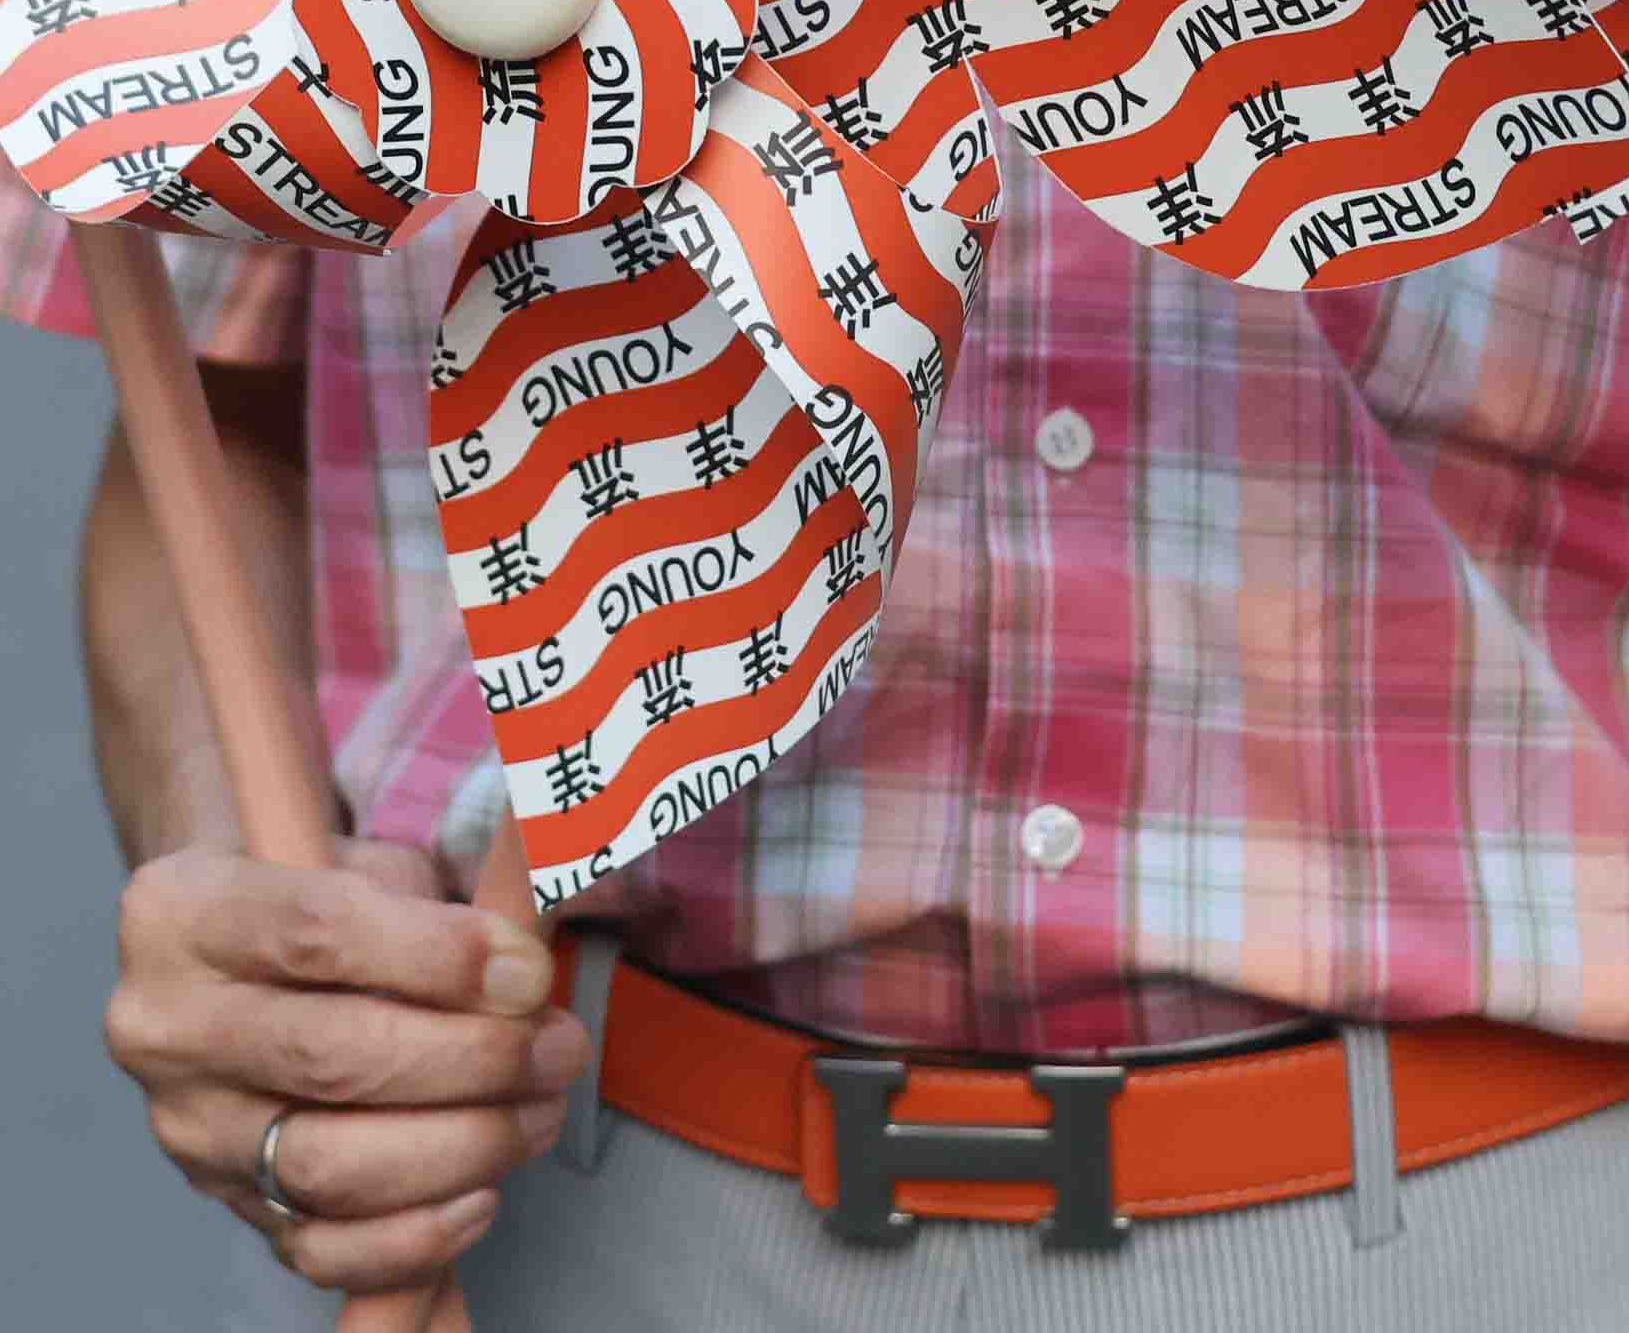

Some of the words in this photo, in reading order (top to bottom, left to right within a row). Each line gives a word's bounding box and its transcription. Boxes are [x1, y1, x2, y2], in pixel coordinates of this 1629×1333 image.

[38, 35, 263, 149] STREAM
[370, 56, 428, 186] UNG
[581, 43, 636, 210] OUNG
[1006, 72, 1148, 162] YOUN
[1290, 156, 1476, 284] STREAM
[522, 317, 693, 428] YOUNG
[597, 527, 755, 636] YOUNG
[478, 635, 564, 715] STR
